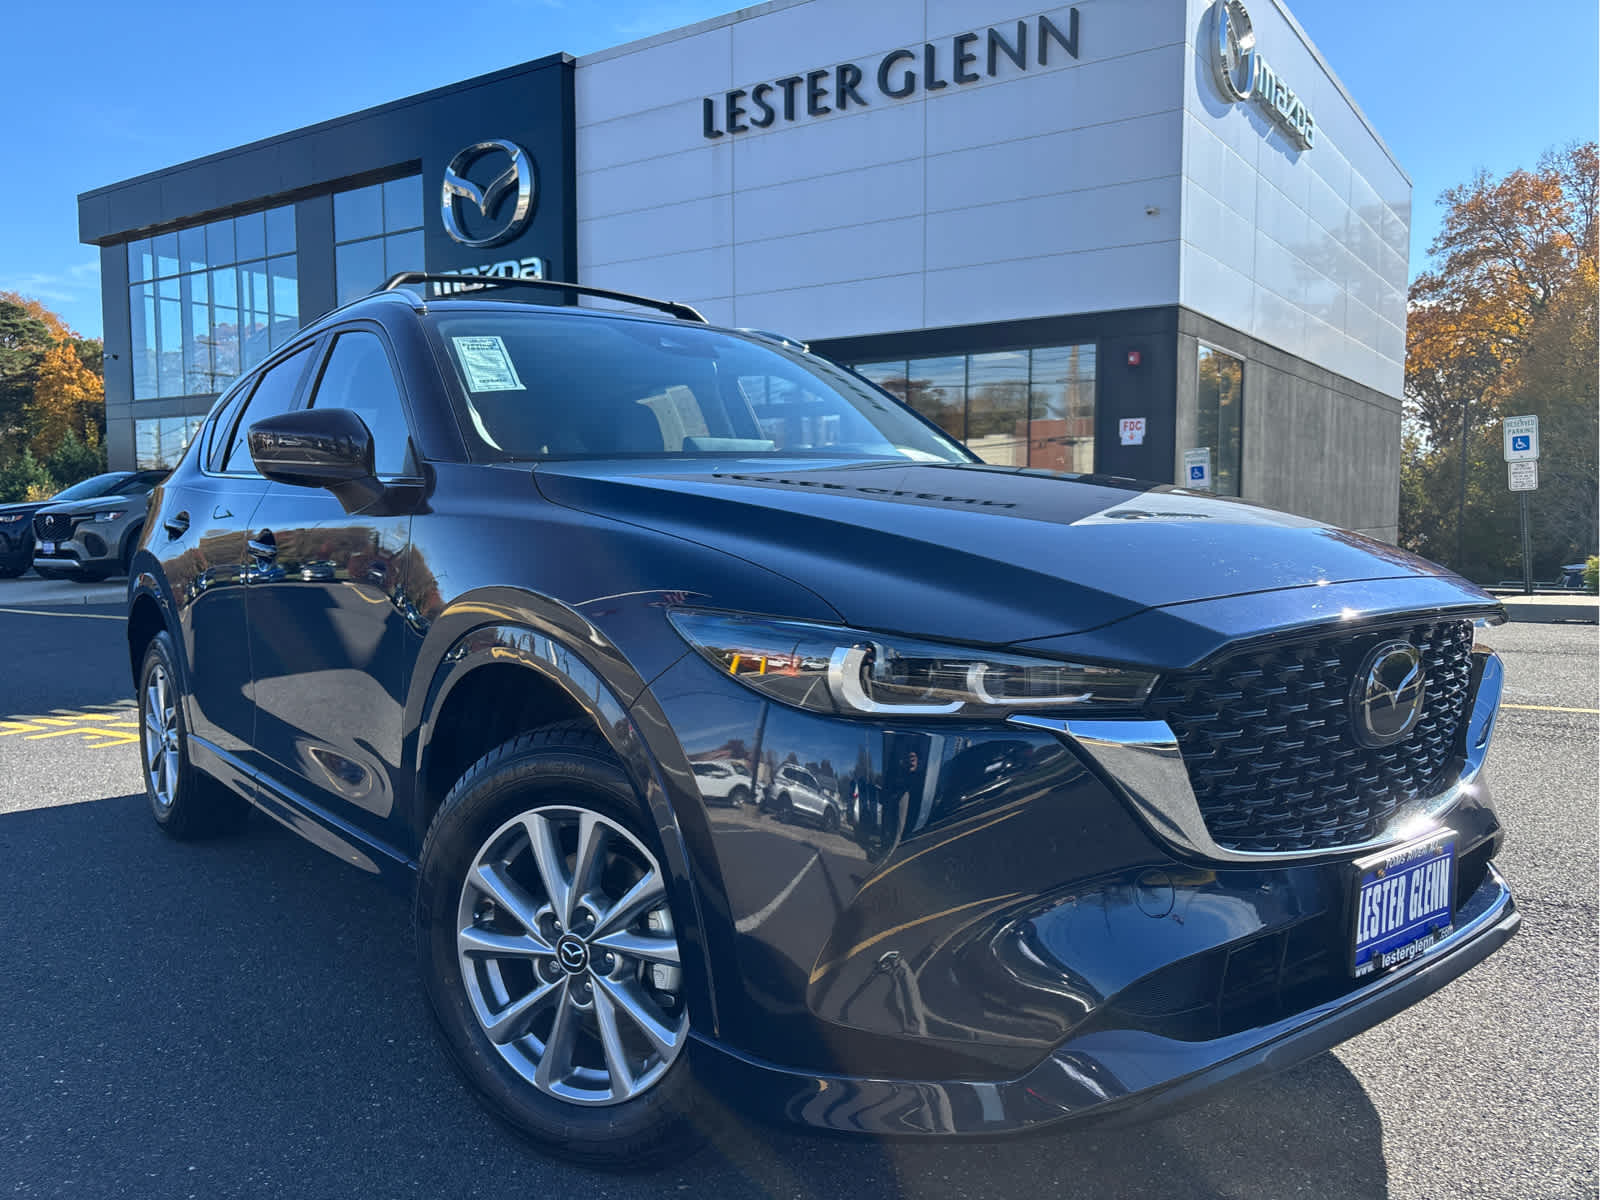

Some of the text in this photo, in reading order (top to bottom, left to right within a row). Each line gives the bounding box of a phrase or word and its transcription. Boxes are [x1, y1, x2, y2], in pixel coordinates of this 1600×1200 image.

[703, 6, 1080, 140] LESTER GLENN
[1254, 53, 1316, 149] mazda
[1123, 420, 1143, 432] FDC
[1506, 418, 1535, 428] RESERVED
[1507, 427, 1534, 435] PARKING
[1357, 857, 1450, 944] LESTER GLENN
